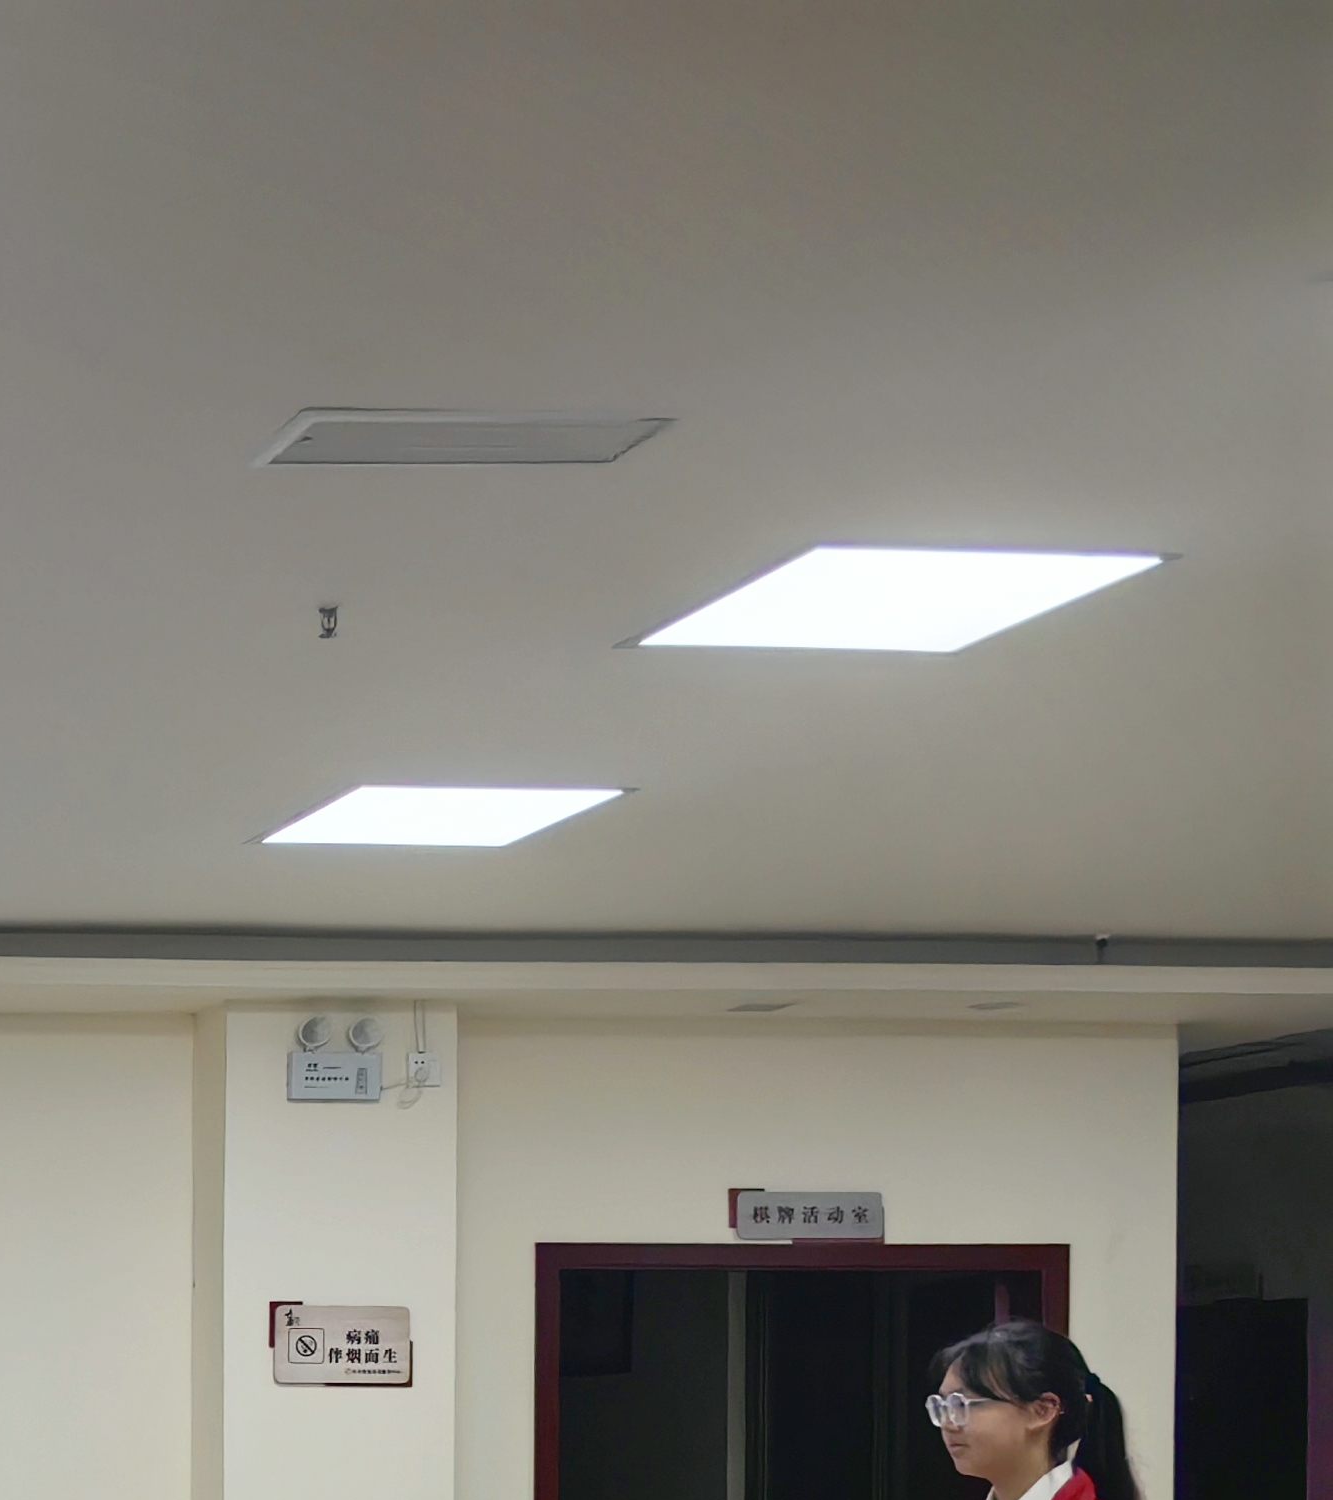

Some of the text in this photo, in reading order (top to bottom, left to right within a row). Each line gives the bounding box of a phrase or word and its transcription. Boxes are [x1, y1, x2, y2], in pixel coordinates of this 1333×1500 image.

[751, 1205, 870, 1225] 棋牌活动室
[328, 1347, 398, 1365] 伴烟而生
